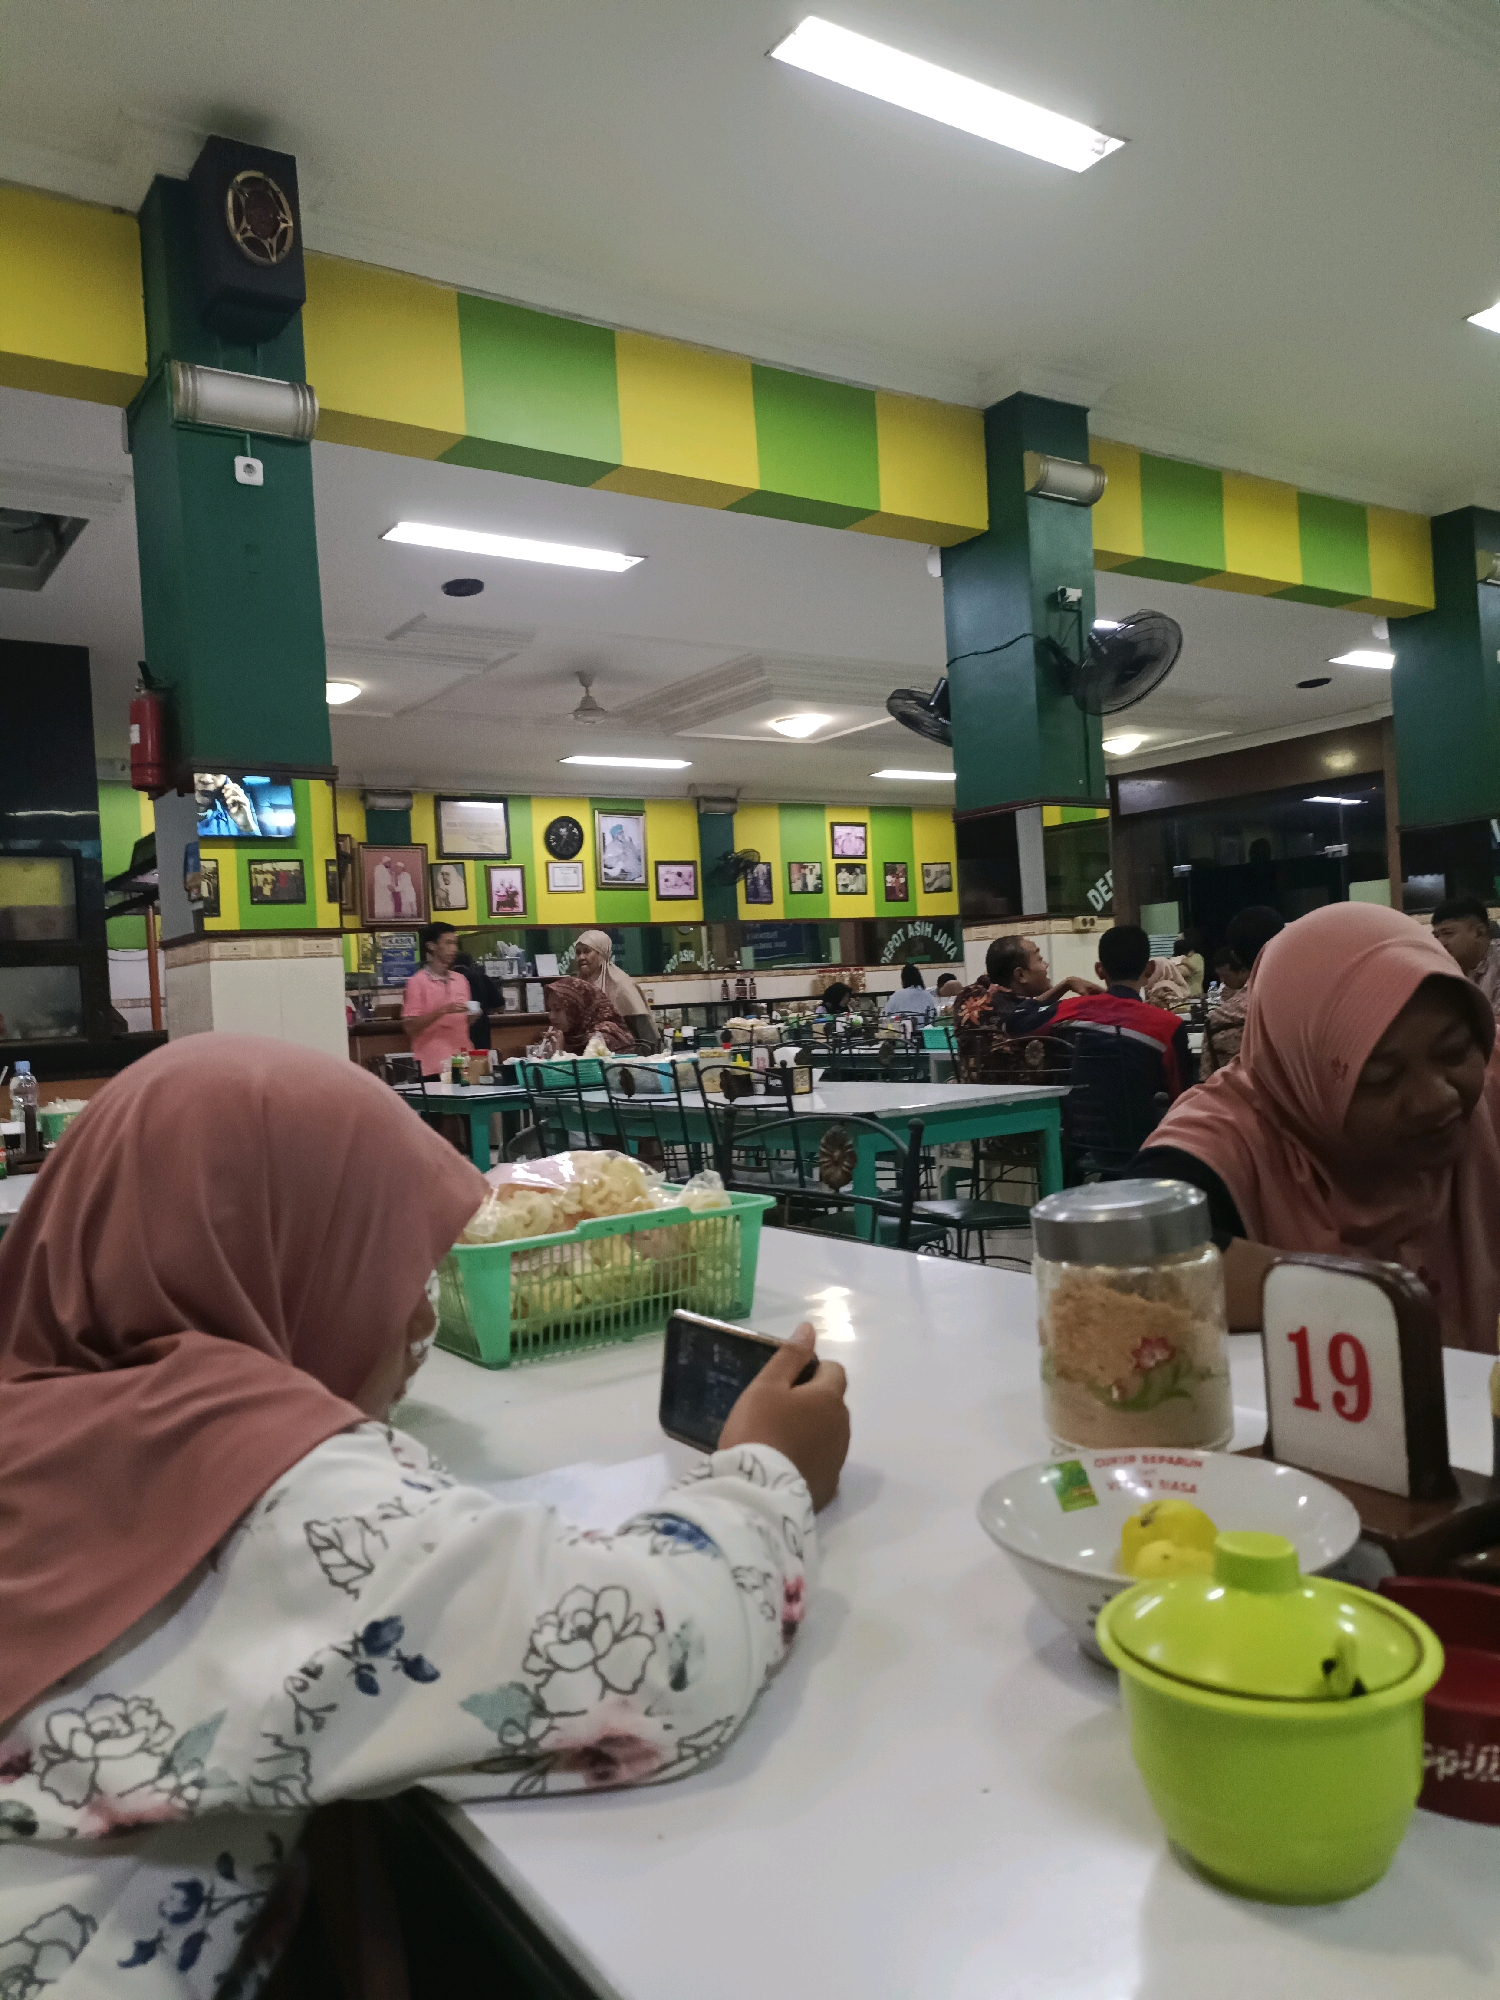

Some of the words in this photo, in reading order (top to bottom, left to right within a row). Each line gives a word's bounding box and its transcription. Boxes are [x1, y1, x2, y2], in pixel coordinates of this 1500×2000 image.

[881, 928, 905, 963] DEPOT
[907, 921, 933, 938] ASIH
[934, 928, 957, 960] JAYA
[1287, 1325, 1372, 1423] 19
